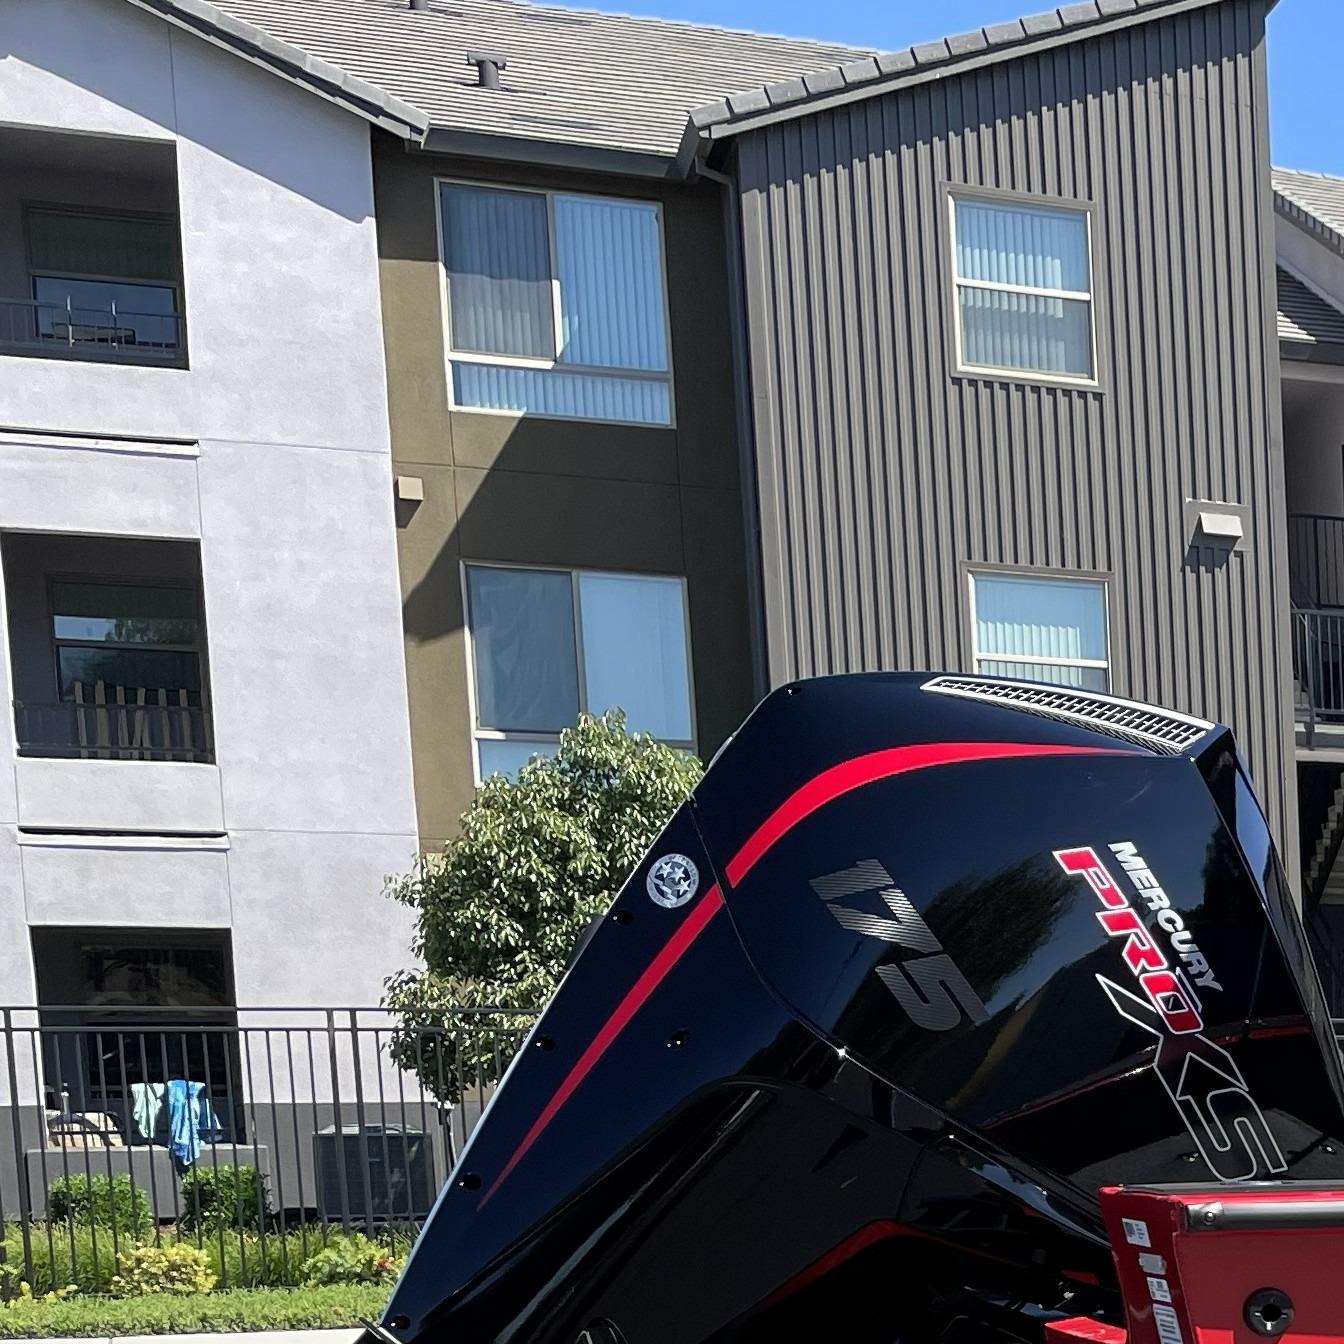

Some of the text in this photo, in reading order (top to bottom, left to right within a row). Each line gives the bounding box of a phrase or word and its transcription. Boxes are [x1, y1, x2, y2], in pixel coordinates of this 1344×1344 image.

[808, 858, 990, 1032] 175
[1107, 841, 1224, 992] MERCURY
[1052, 846, 1288, 1182] PRO XS
